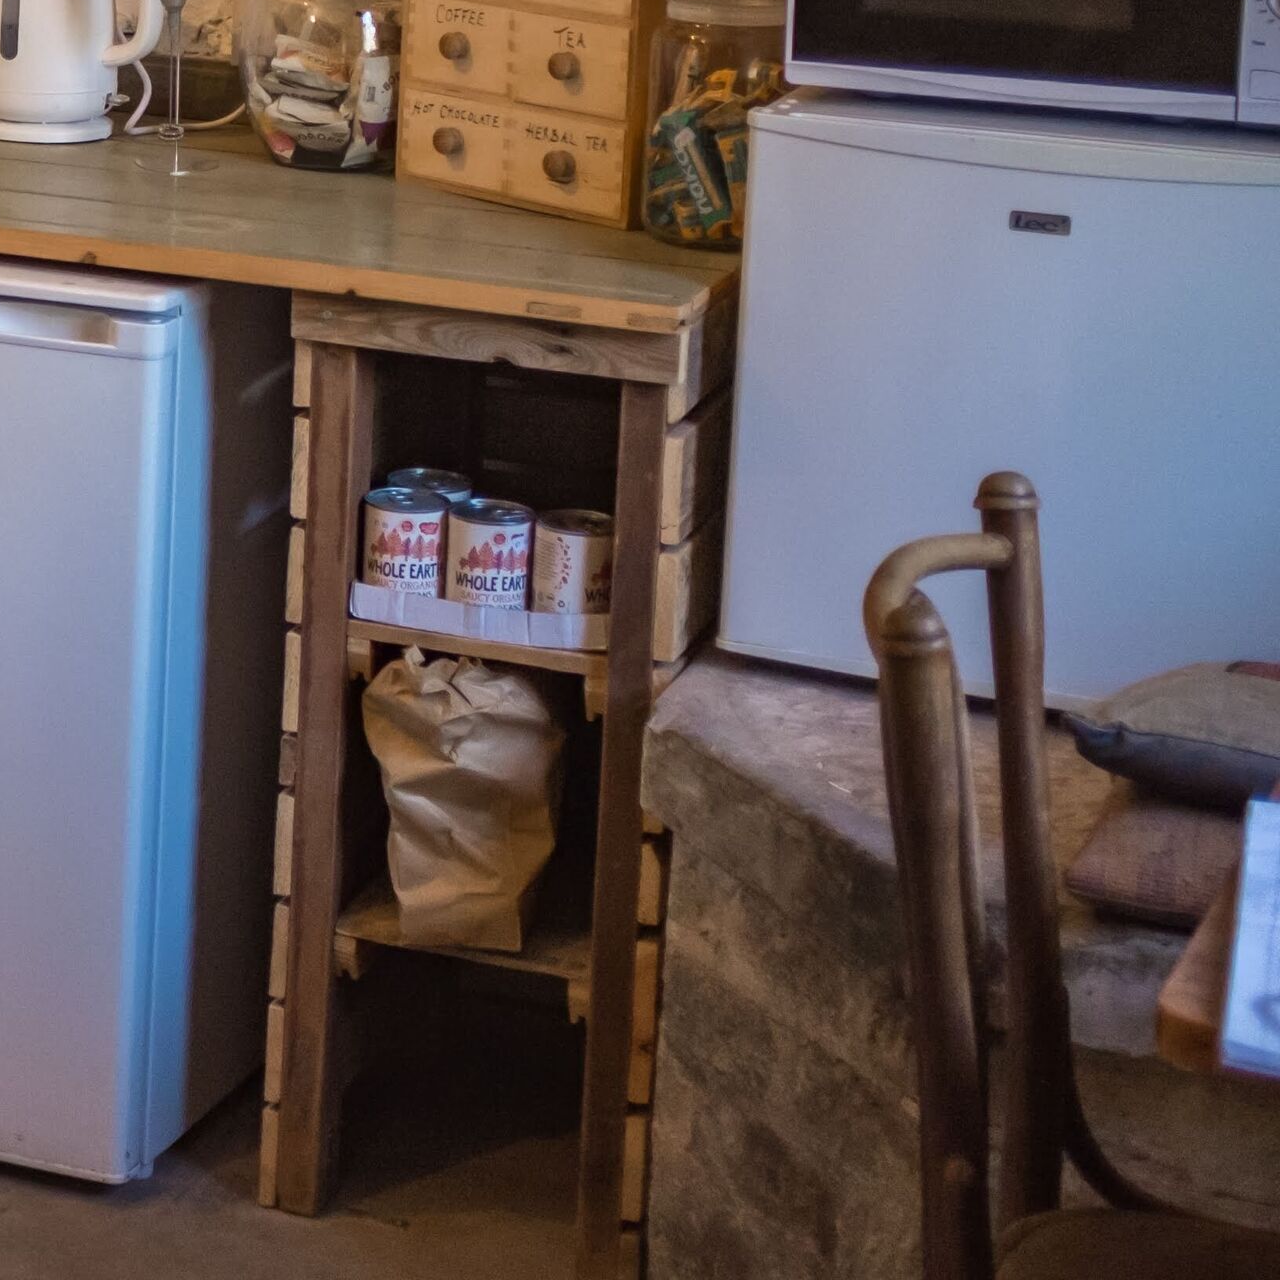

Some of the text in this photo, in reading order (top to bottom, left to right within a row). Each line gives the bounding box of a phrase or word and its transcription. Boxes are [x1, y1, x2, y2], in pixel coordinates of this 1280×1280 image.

[436, 4, 485, 27] COFFEE
[554, 26, 586, 49] TEA
[412, 103, 500, 128] HOT CHOCOLATE
[524, 122, 608, 152] HERBAL TEA
[367, 558, 405, 579] WHOLE
[455, 572, 527, 592] WHOLE EART
[492, 593, 522, 602] ORGAN
